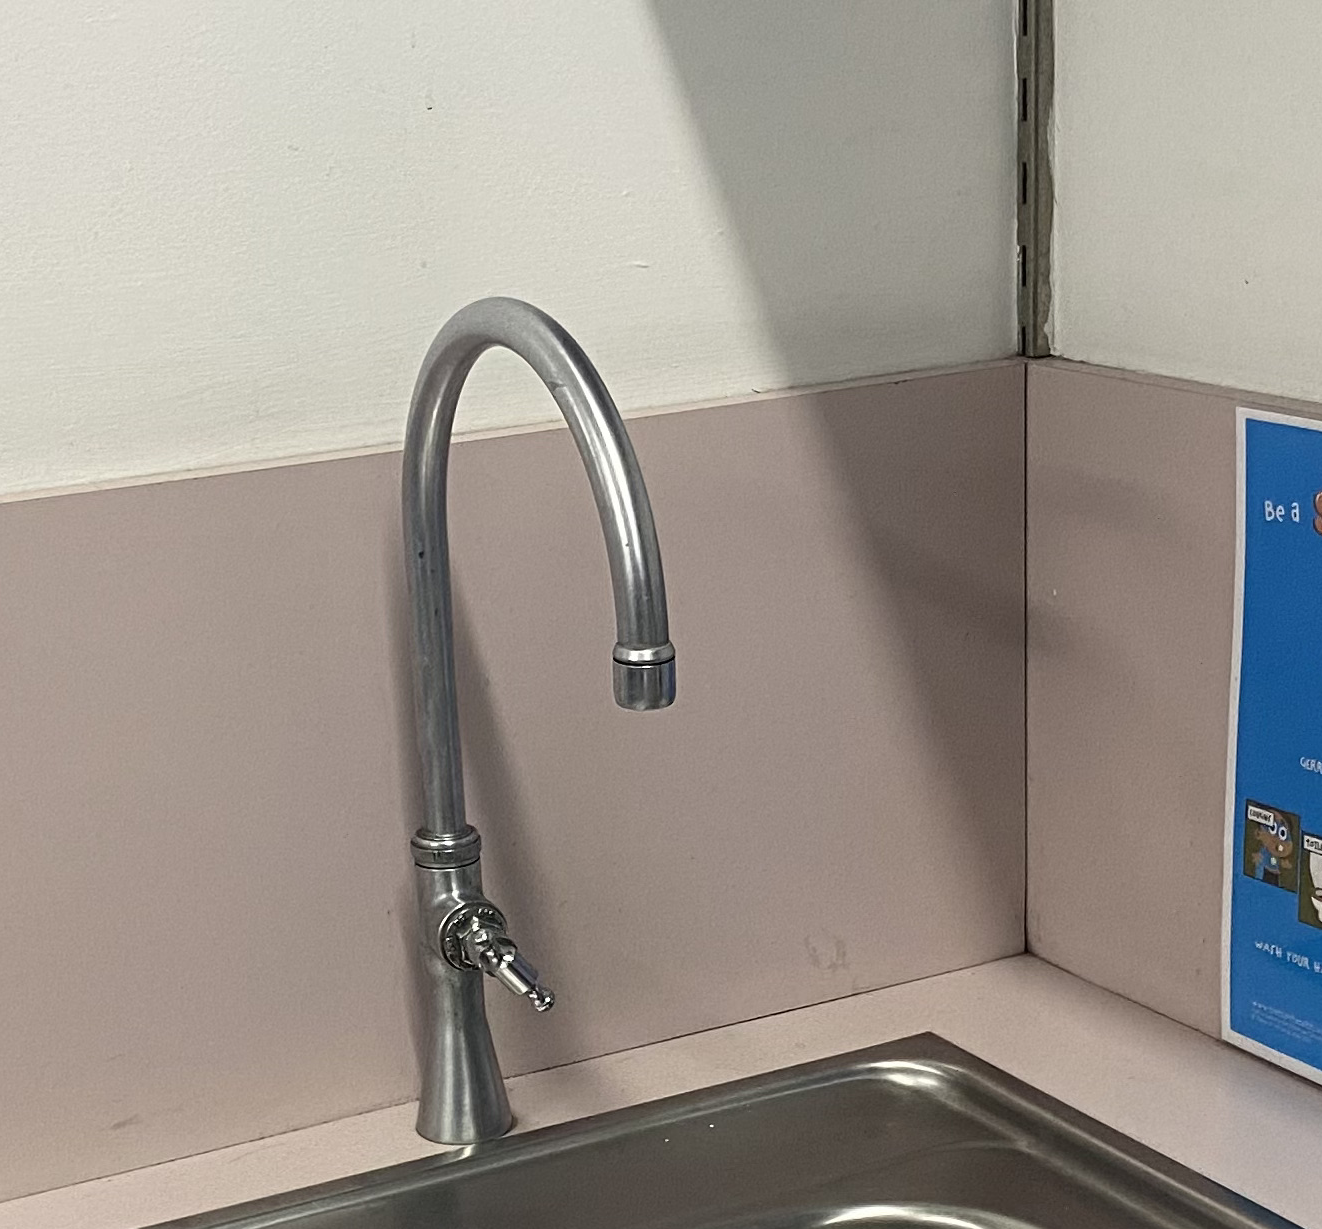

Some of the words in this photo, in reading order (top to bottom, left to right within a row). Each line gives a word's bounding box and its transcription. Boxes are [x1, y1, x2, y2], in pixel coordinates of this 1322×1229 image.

[1265, 501, 1285, 522] Be
[1291, 502, 1300, 522] a
[1255, 942, 1282, 957] WASH
[1287, 952, 1309, 969] YOUR
